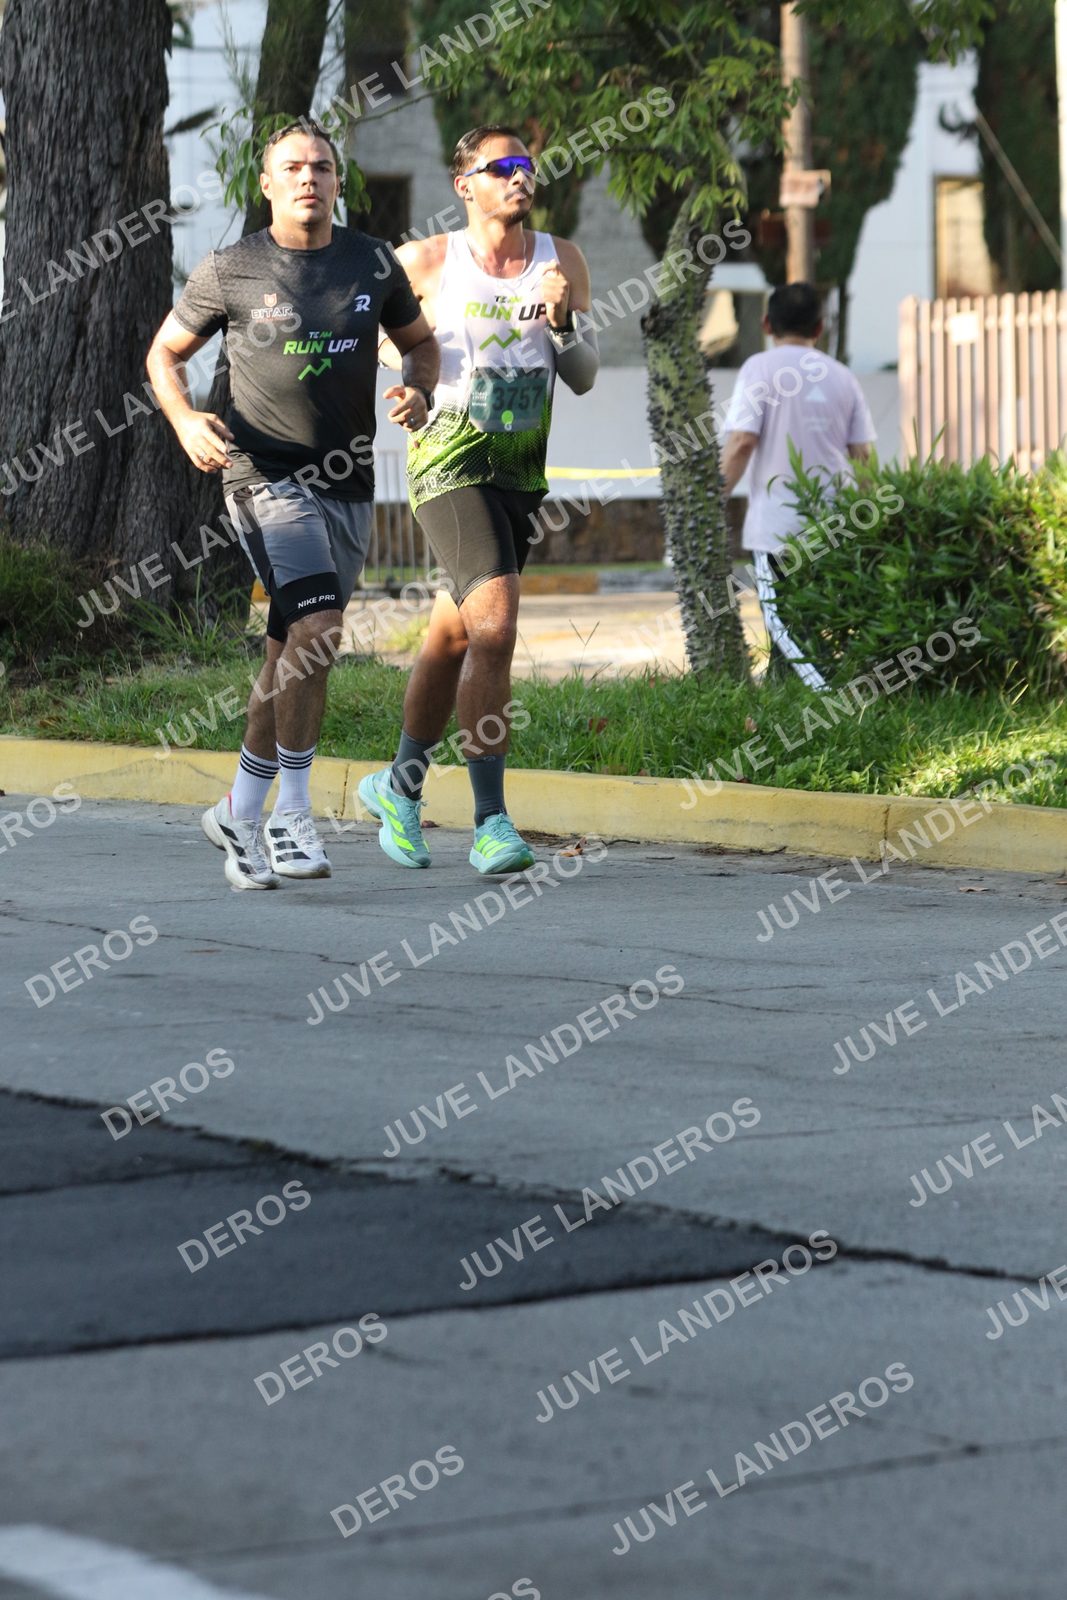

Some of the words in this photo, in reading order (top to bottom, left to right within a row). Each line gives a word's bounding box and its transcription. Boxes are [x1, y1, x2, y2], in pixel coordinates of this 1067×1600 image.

[250, 306, 294, 320] BITAR
[464, 302, 514, 321] RUN
[308, 331, 333, 339] TEAM
[283, 340, 325, 355] RUN
[328, 338, 359, 353] UP!
[492, 385, 544, 411] 3757
[298, 596, 318, 609] NIKE
[319, 594, 336, 602] PRO
